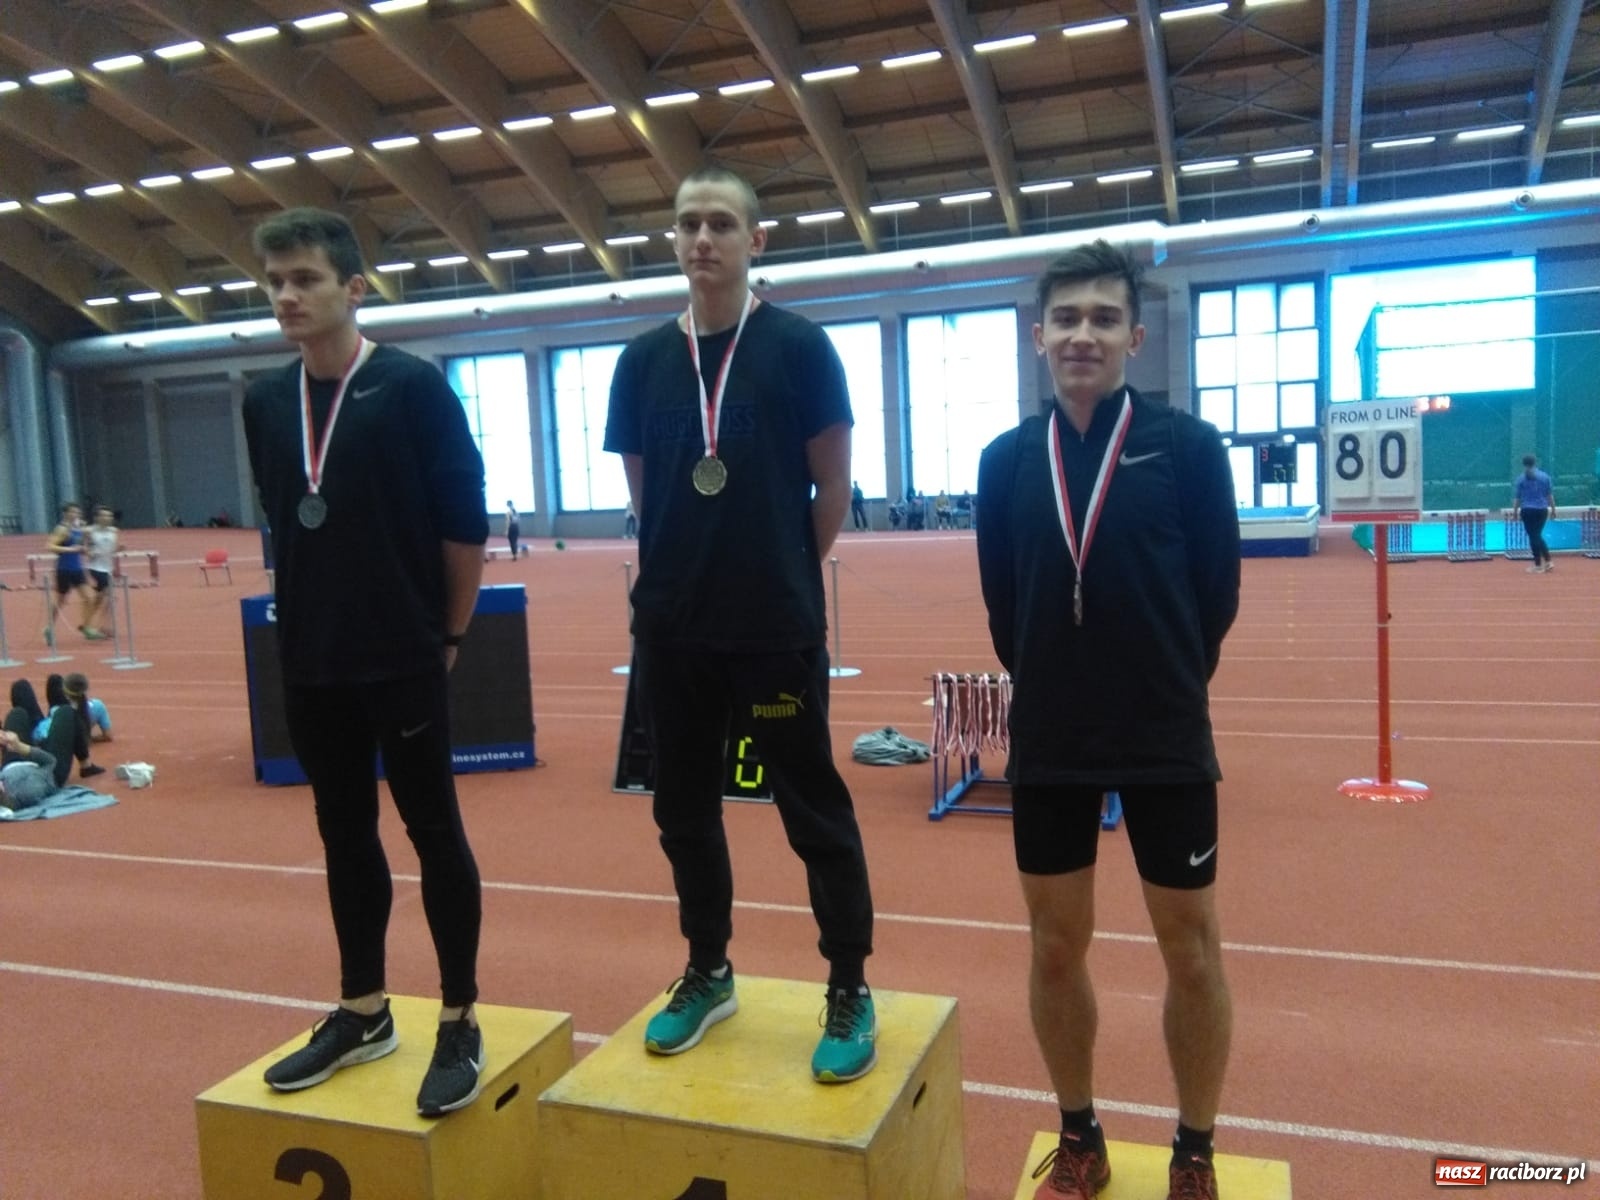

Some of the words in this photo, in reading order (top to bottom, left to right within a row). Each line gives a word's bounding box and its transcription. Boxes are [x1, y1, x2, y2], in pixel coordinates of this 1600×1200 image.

[1331, 410, 1369, 424] FROM
[1387, 406, 1418, 420] LINE
[1336, 431, 1407, 480] 80
[752, 703, 796, 717] PUMA
